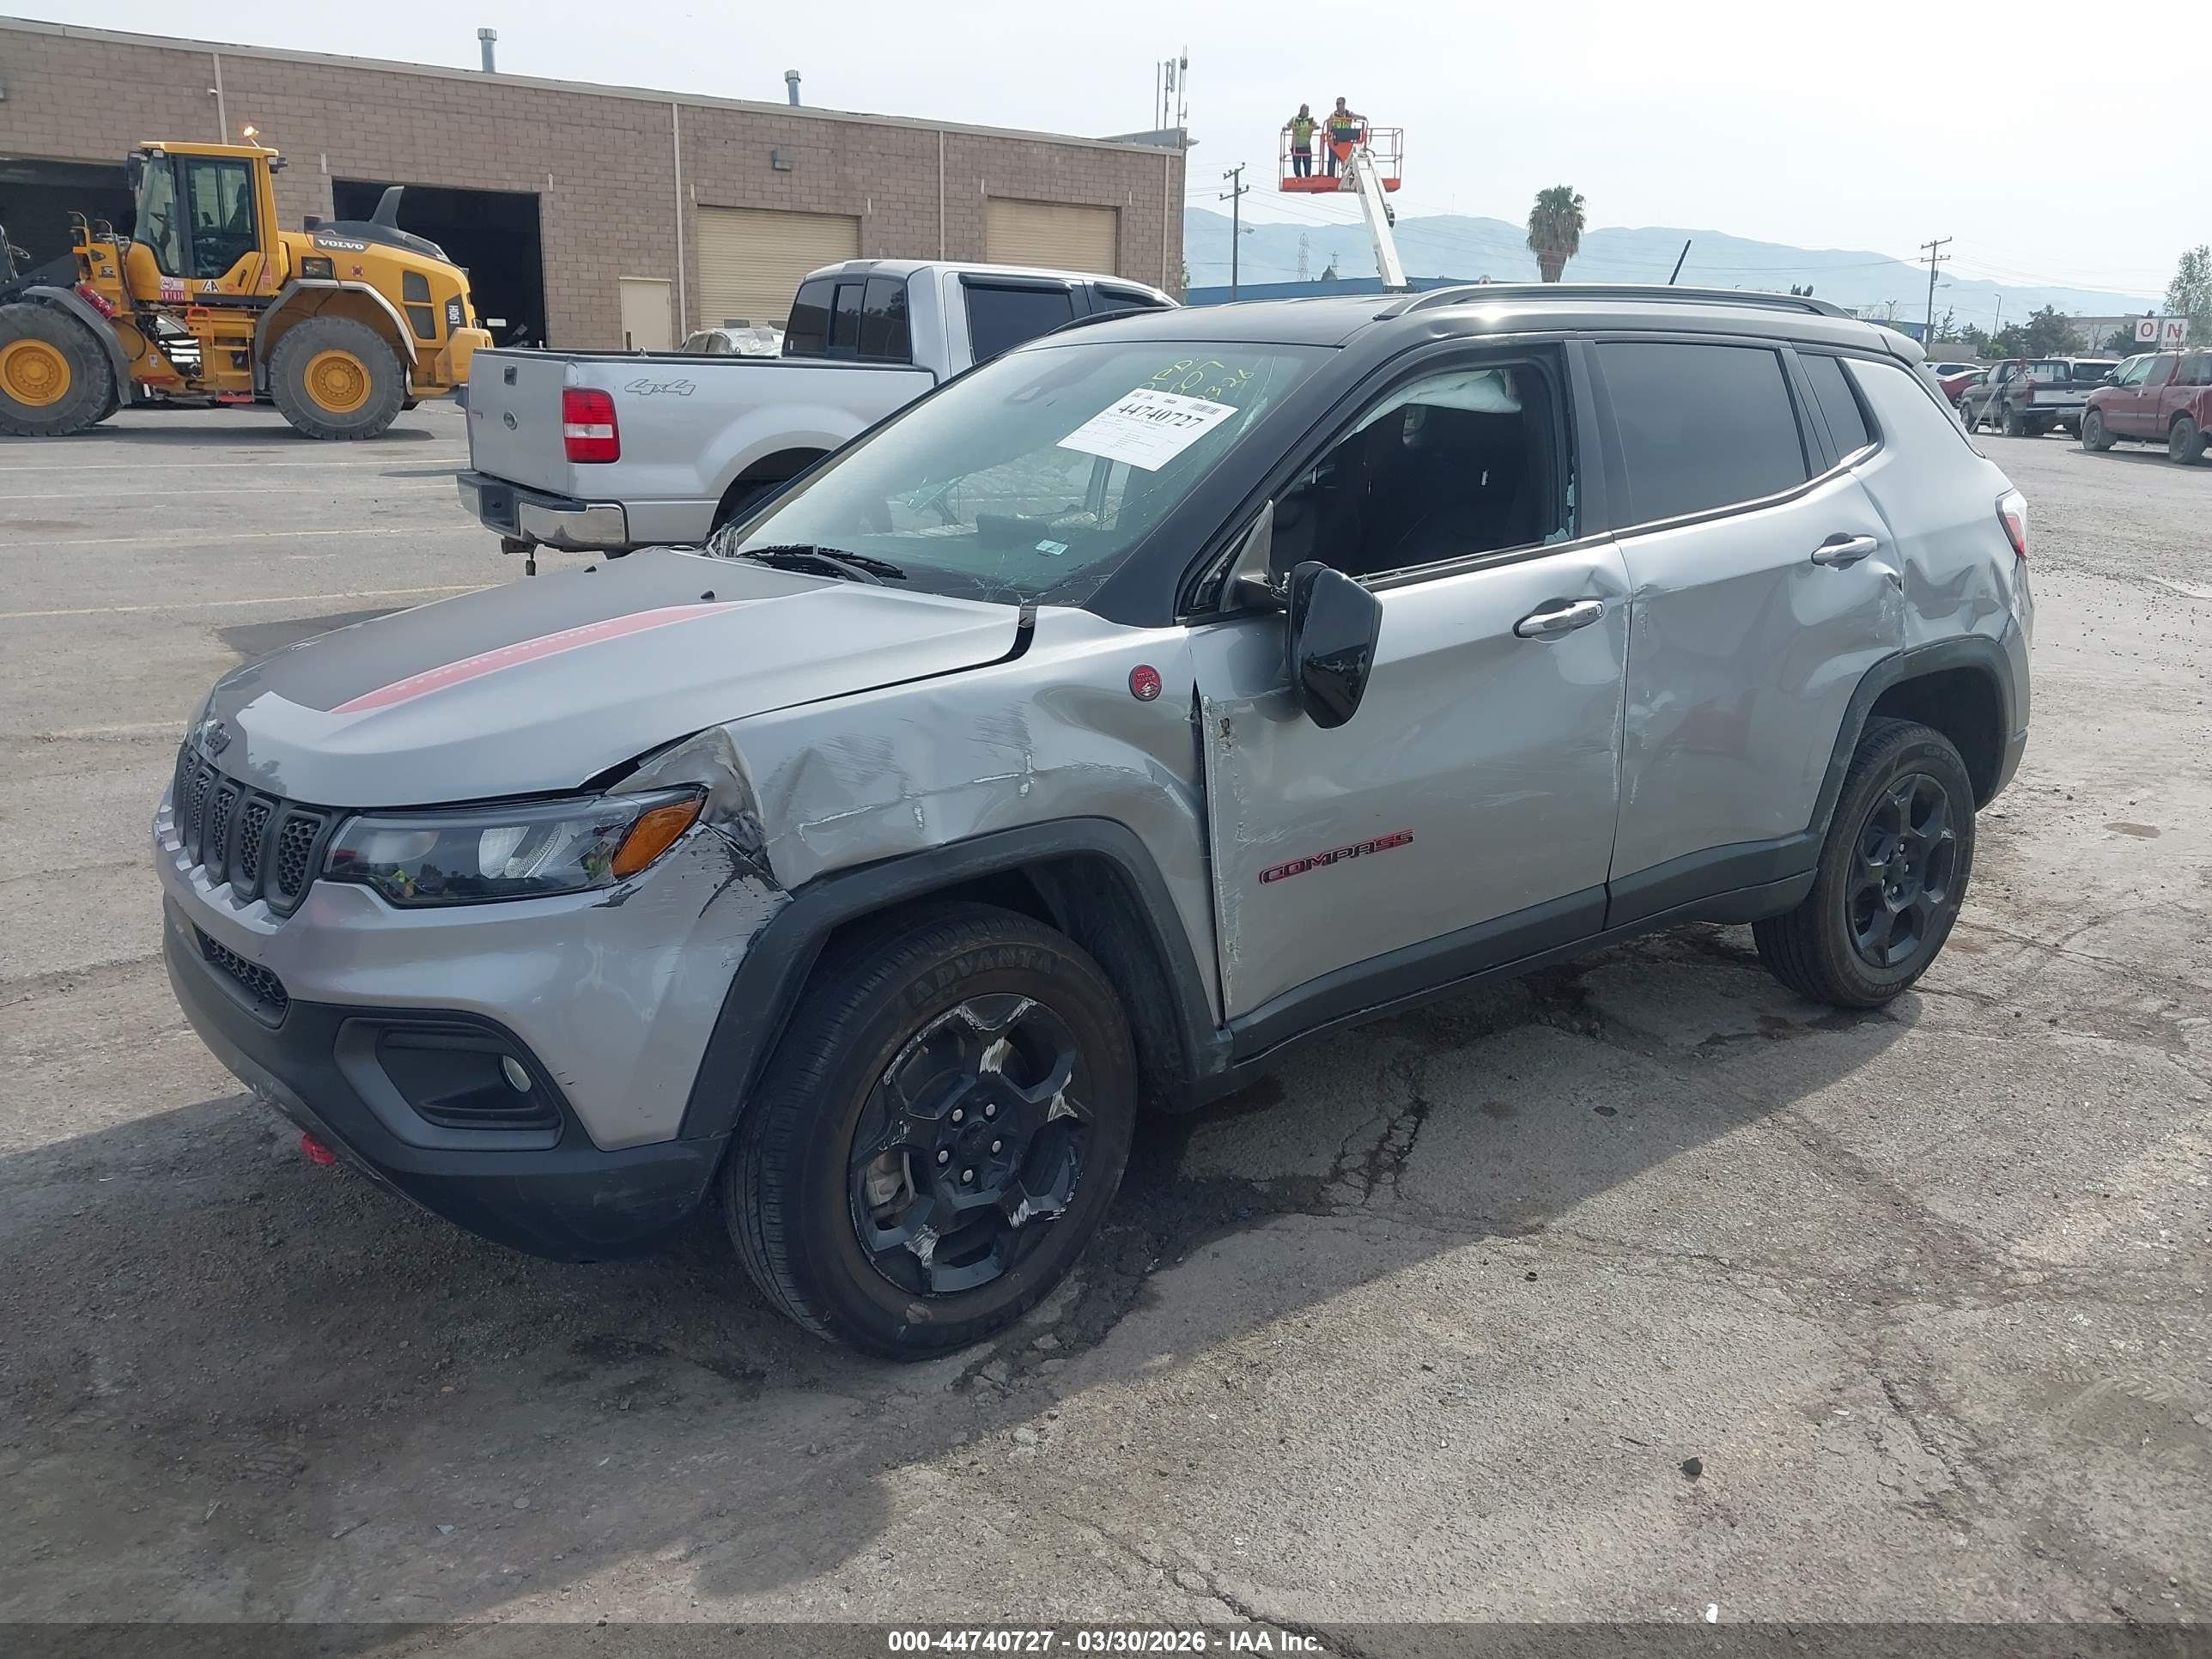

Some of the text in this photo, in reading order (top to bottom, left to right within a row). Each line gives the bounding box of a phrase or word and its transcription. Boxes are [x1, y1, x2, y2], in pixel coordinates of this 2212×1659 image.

[318, 239, 365, 250] VOLVO
[449, 305, 460, 325] L90H
[624, 378, 696, 396] 4x4
[1117, 403, 1205, 429] 44740727
[1259, 829, 1415, 885] COMPASS
[913, 946, 1053, 1007] ADVANTA
